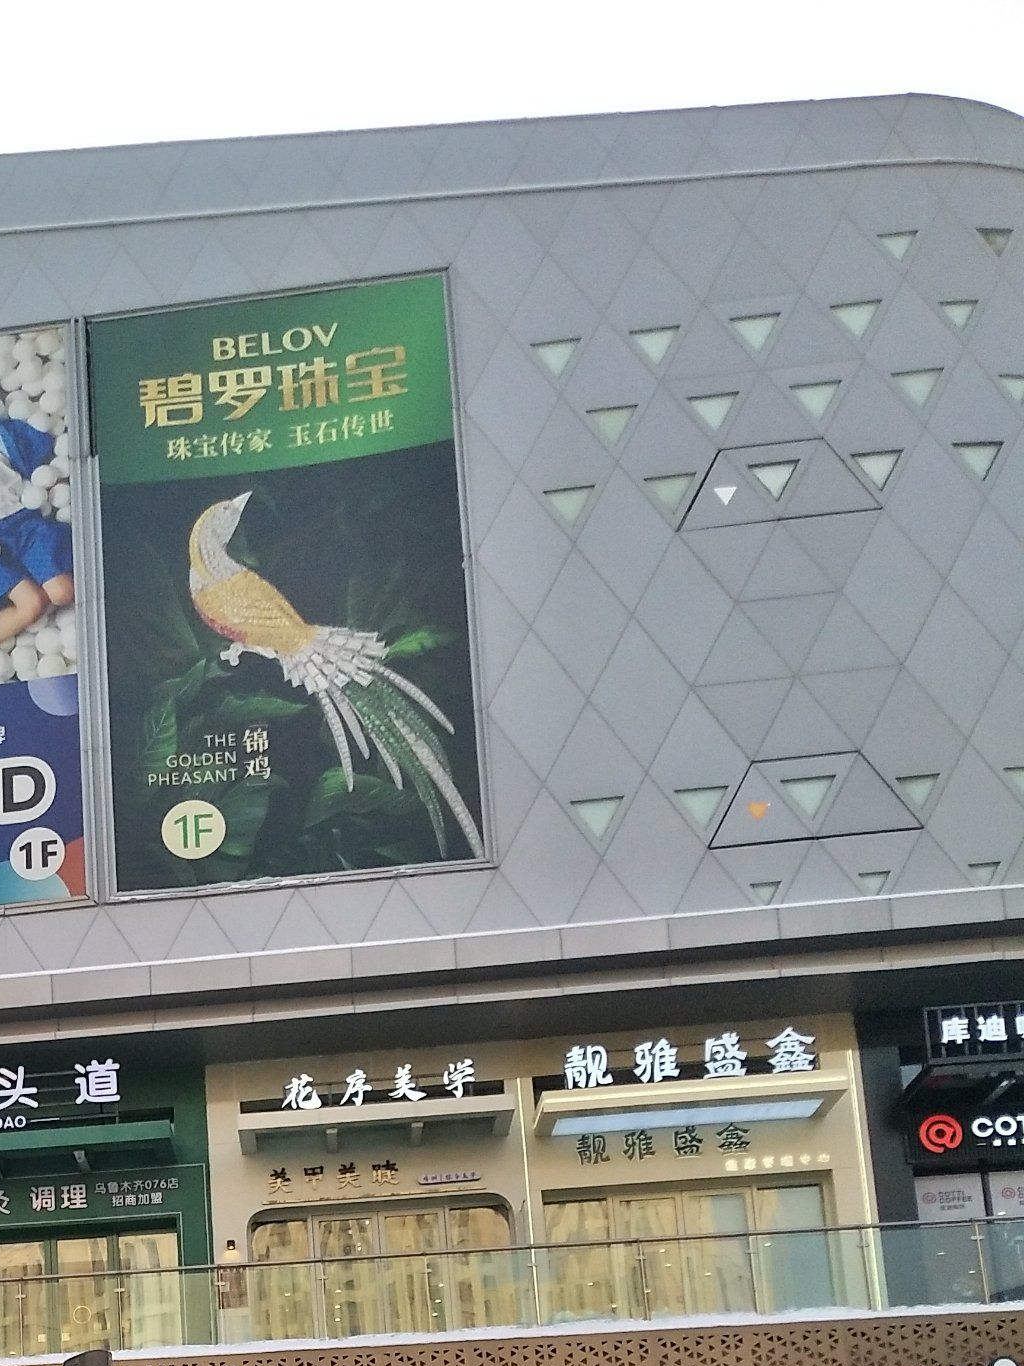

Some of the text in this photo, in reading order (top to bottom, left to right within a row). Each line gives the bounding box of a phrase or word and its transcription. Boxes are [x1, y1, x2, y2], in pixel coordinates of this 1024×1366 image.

[212, 323, 339, 361] BELOV
[138, 345, 409, 428] 碧罗珠宝
[166, 409, 394, 461] 珠宝传家 玉石传世
[204, 734, 236, 748] THE
[166, 751, 237, 768] GOLDEN
[148, 767, 237, 787] PHEASANT
[173, 814, 213, 849] 1F
[17, 841, 59, 872] 1F
[564, 1027, 816, 1090] 靓雅盛鑫
[281, 1058, 476, 1110] 花序美学
[30, 1184, 88, 1211] 调理
[94, 1178, 179, 1194] 乌鲁木齐076店
[112, 1192, 163, 1207] 招商加盟
